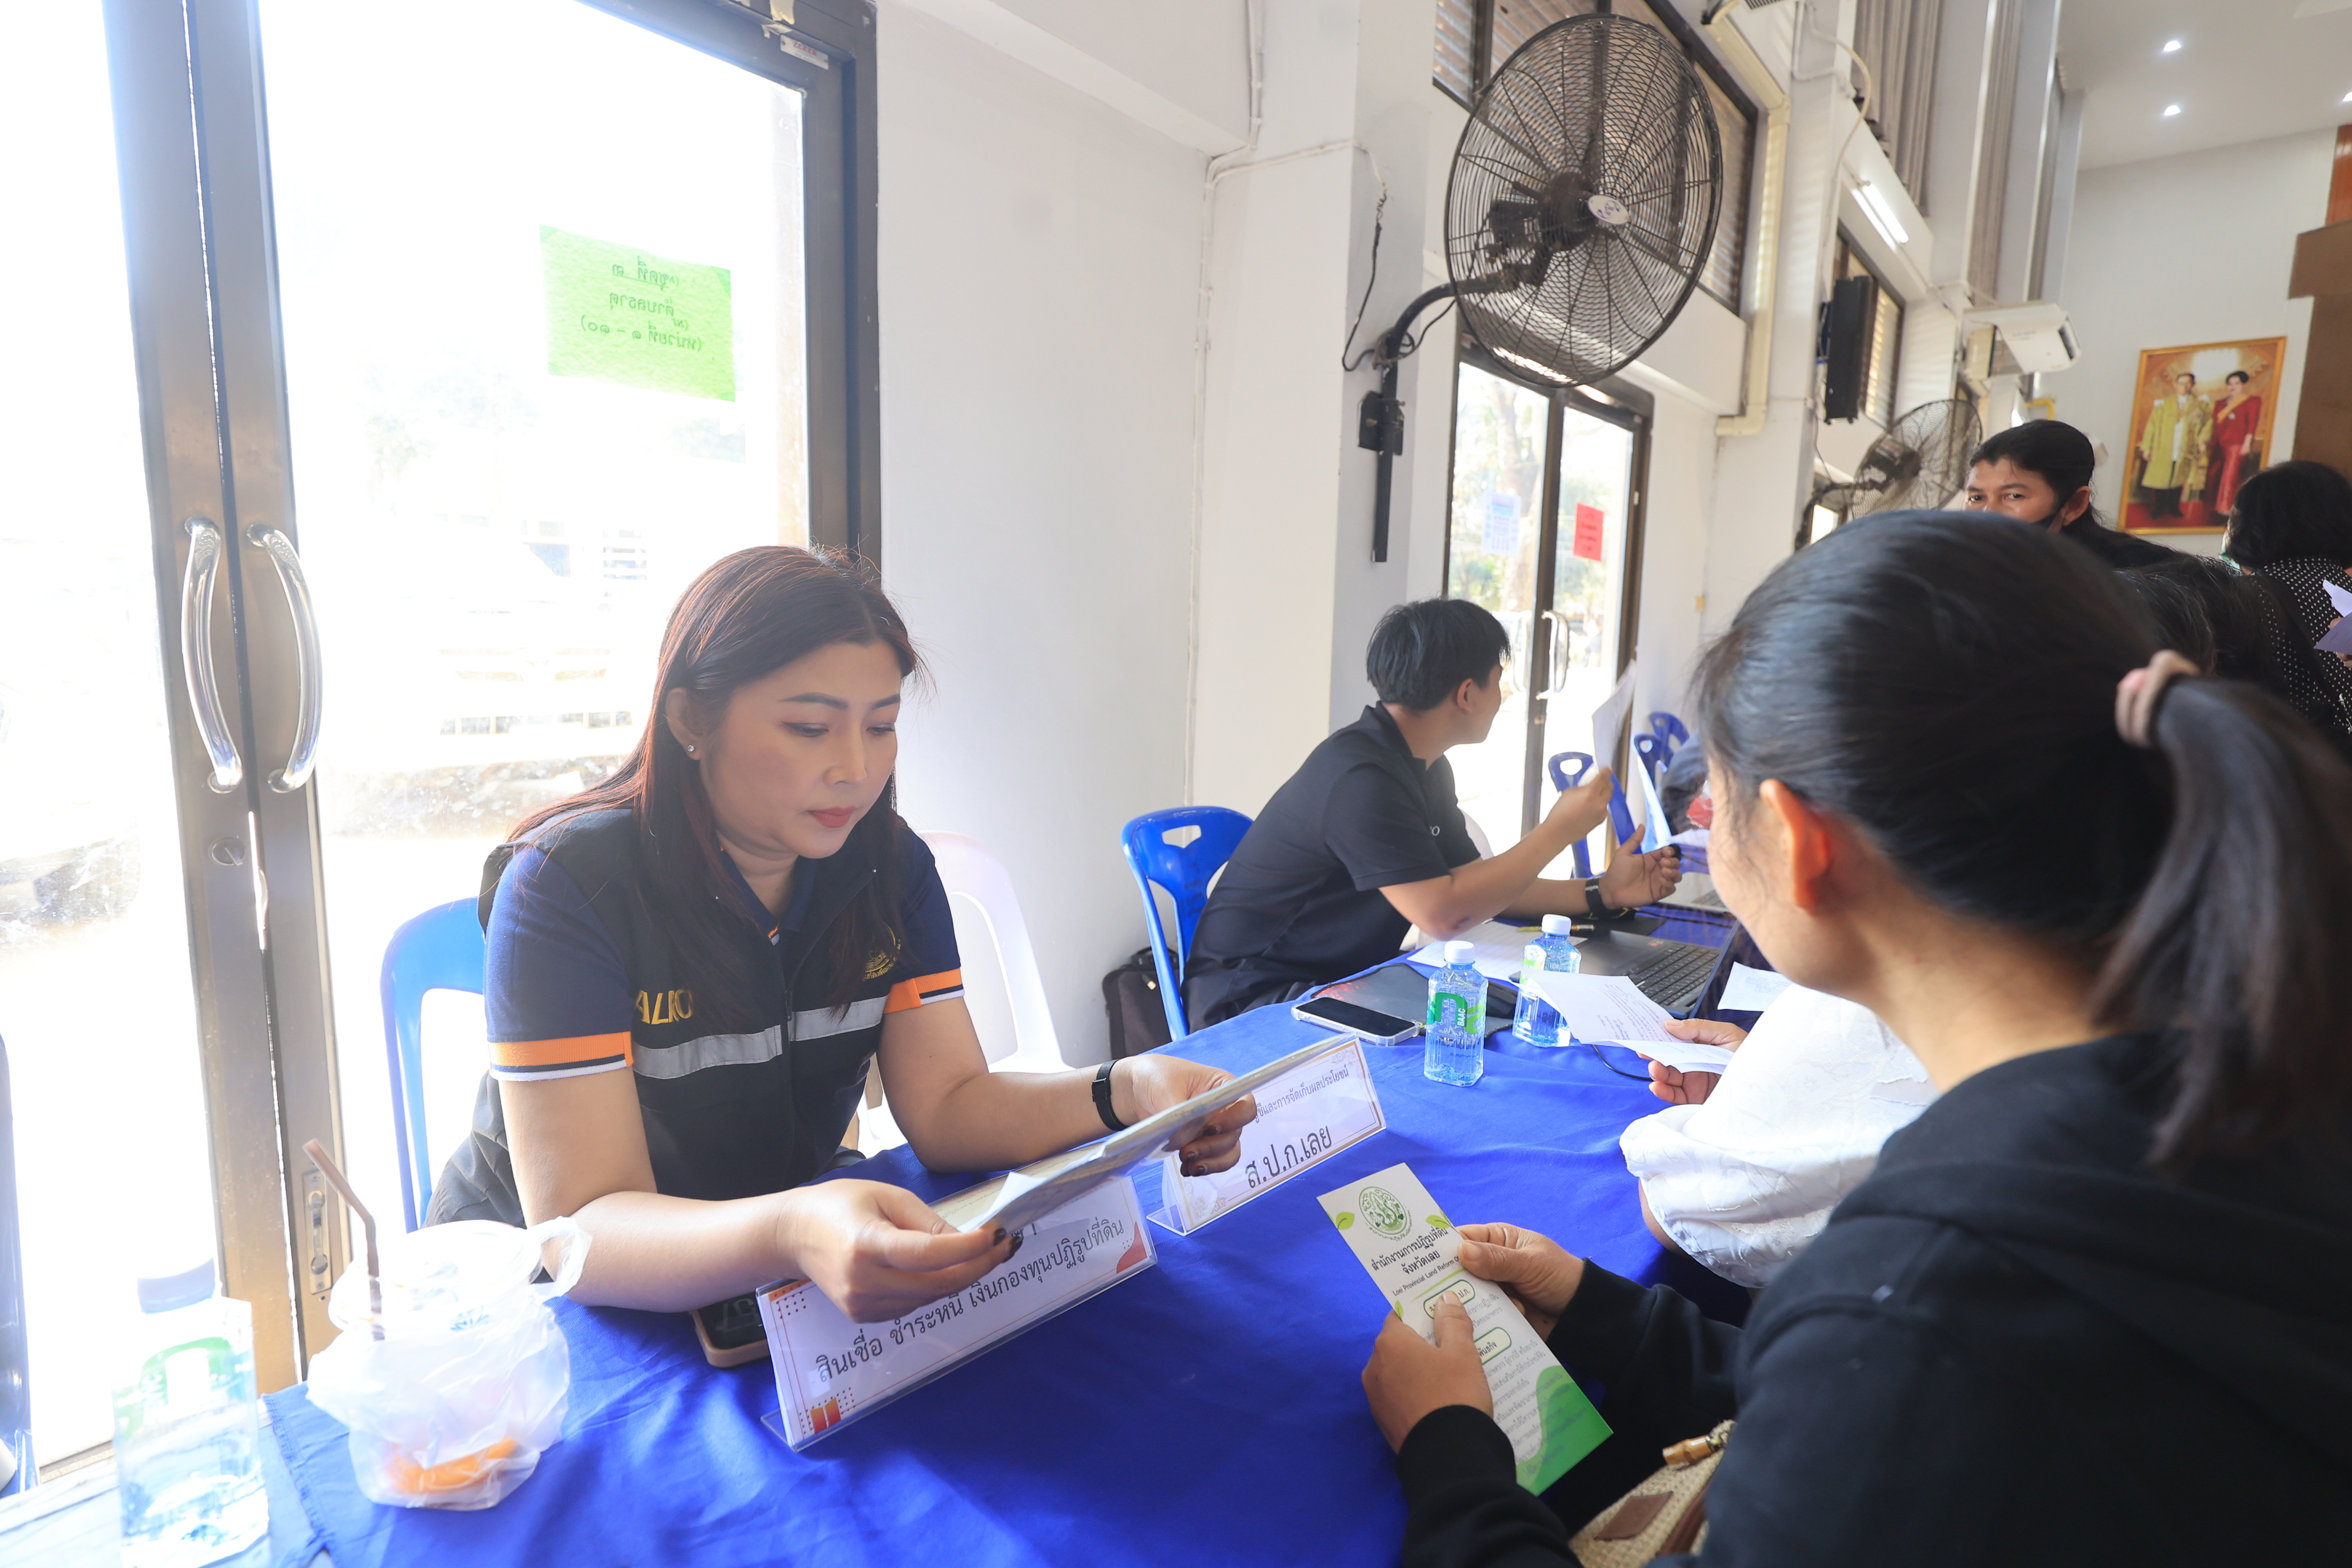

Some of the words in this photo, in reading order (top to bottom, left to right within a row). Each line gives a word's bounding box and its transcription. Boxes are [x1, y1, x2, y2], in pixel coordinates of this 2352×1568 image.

[1457, 1008, 1466, 1027] BAAC
[1255, 1064, 1349, 1123] ชีและการจัดเก็บผลประโยชน์
[1245, 1126, 1332, 1188] ส.ป.ก.เลย
[1371, 1226, 1449, 1271] สำนักงานการปฏิรูปที่ดิน
[1401, 1250, 1440, 1275] จังหวัดเลย
[1392, 1287, 1404, 1296] Loei
[1403, 1275, 1426, 1291] Provincial
[1425, 1268, 1438, 1279] Land
[1438, 1260, 1455, 1272] Reform
[816, 1328, 883, 1383] สินเชื่อ
[890, 1292, 963, 1345] ชำระหนี
[969, 1217, 1124, 1308] เงินกองทุนปฏิรูปที่ดิน
[1478, 1341, 1498, 1358] พันธกิจ
